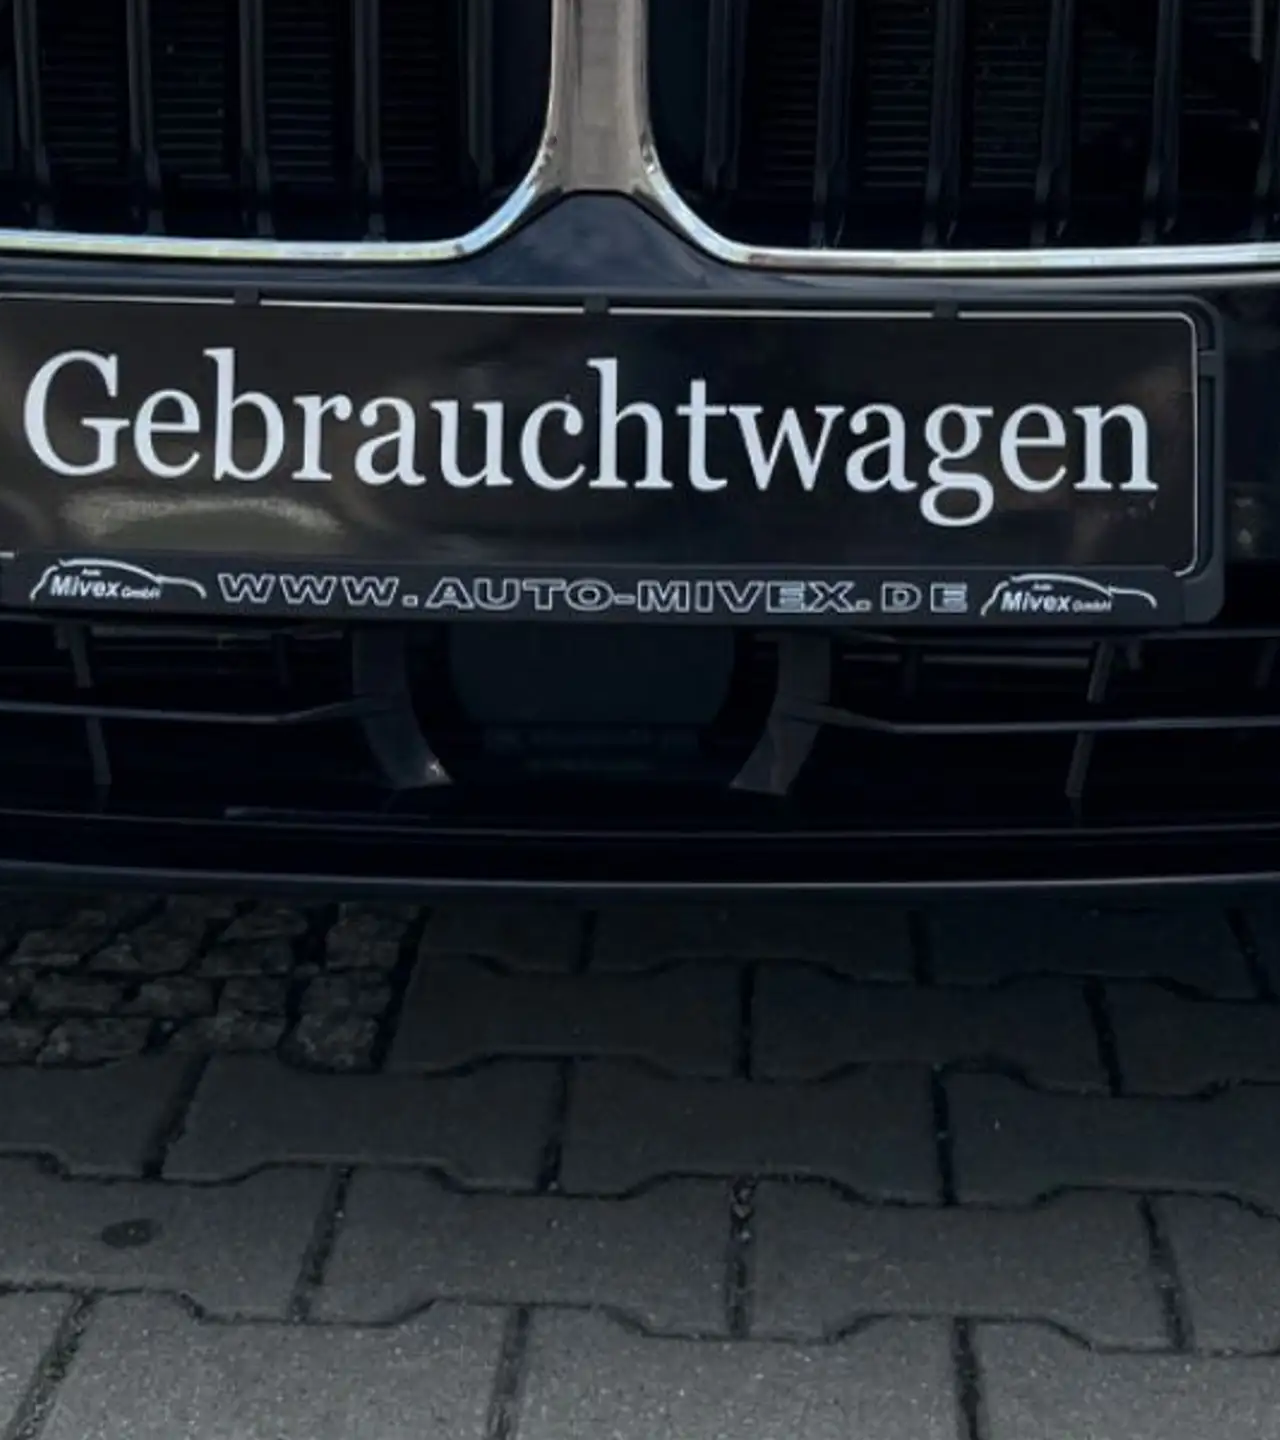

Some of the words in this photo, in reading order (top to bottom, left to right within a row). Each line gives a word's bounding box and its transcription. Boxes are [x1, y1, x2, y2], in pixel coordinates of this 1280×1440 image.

[23, 347, 1158, 527] Gebrauchtwagen
[50, 575, 121, 597] Mivex
[217, 573, 968, 613] WWW.AUTO-MIVEX.DE
[1000, 591, 1071, 613] Mivex
